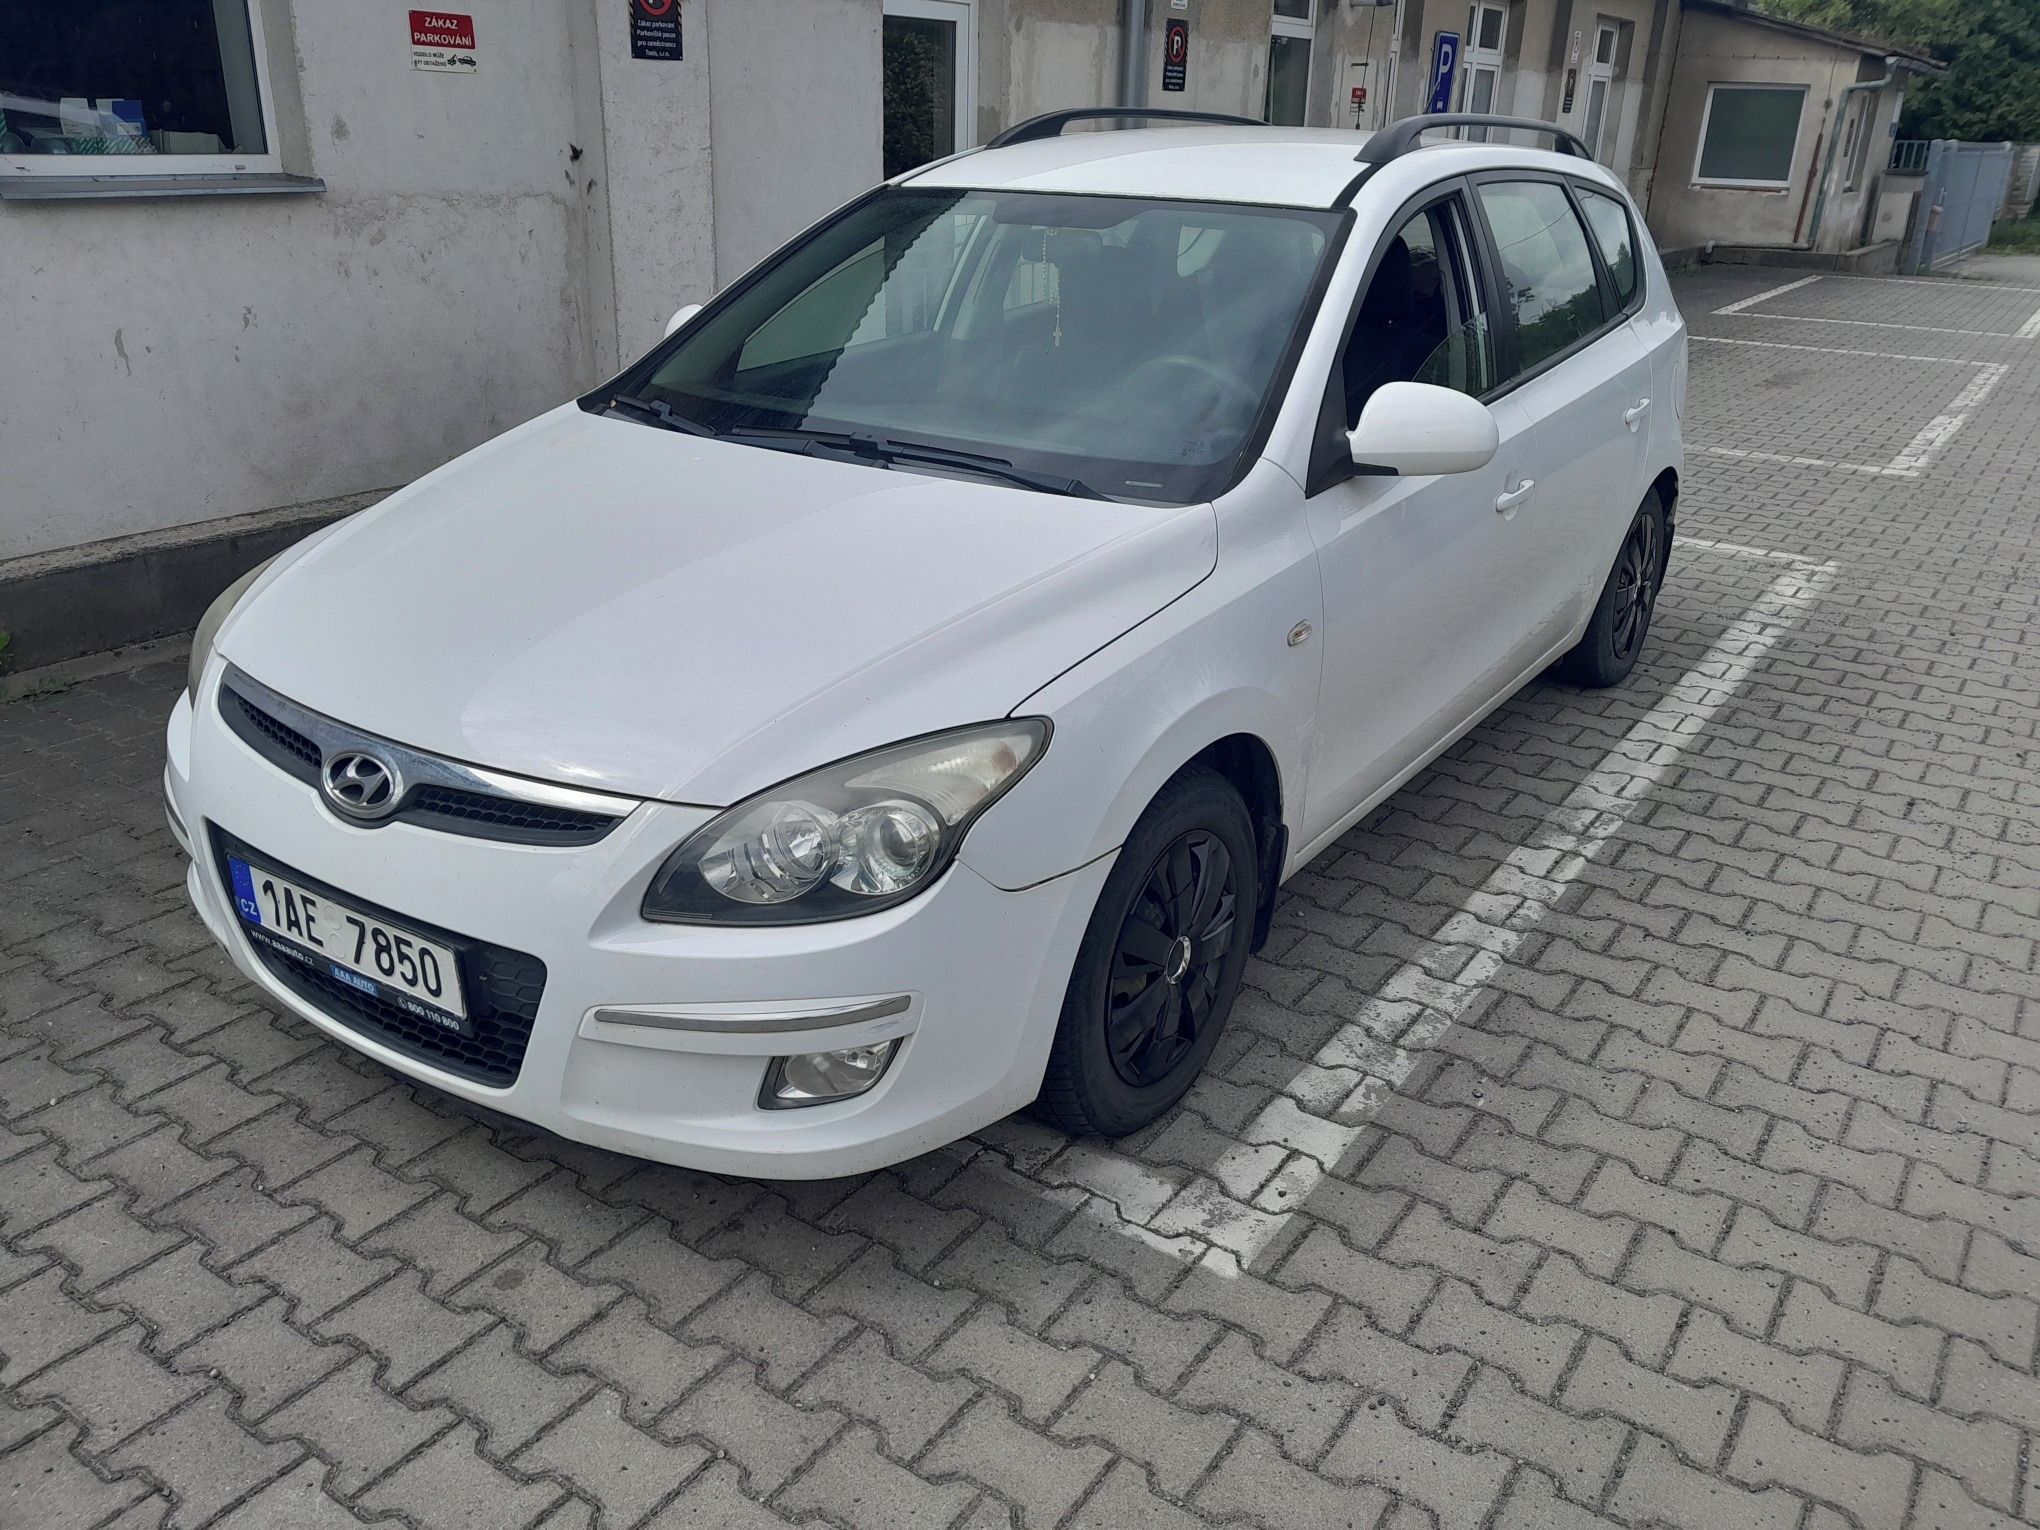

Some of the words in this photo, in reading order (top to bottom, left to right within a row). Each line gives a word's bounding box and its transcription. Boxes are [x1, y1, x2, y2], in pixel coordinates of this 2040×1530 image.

[425, 16, 458, 29] ZÁKAZ
[414, 32, 472, 46] PARKOVÁNÍ
[241, 898, 257, 916] CZ
[262, 879, 324, 948] 1AE
[345, 913, 442, 998] 7850
[334, 967, 351, 982] AAA
[352, 976, 376, 993] AUTO
[407, 1001, 425, 1017] 800
[425, 1008, 442, 1023] 110
[441, 1015, 461, 1031] 800
